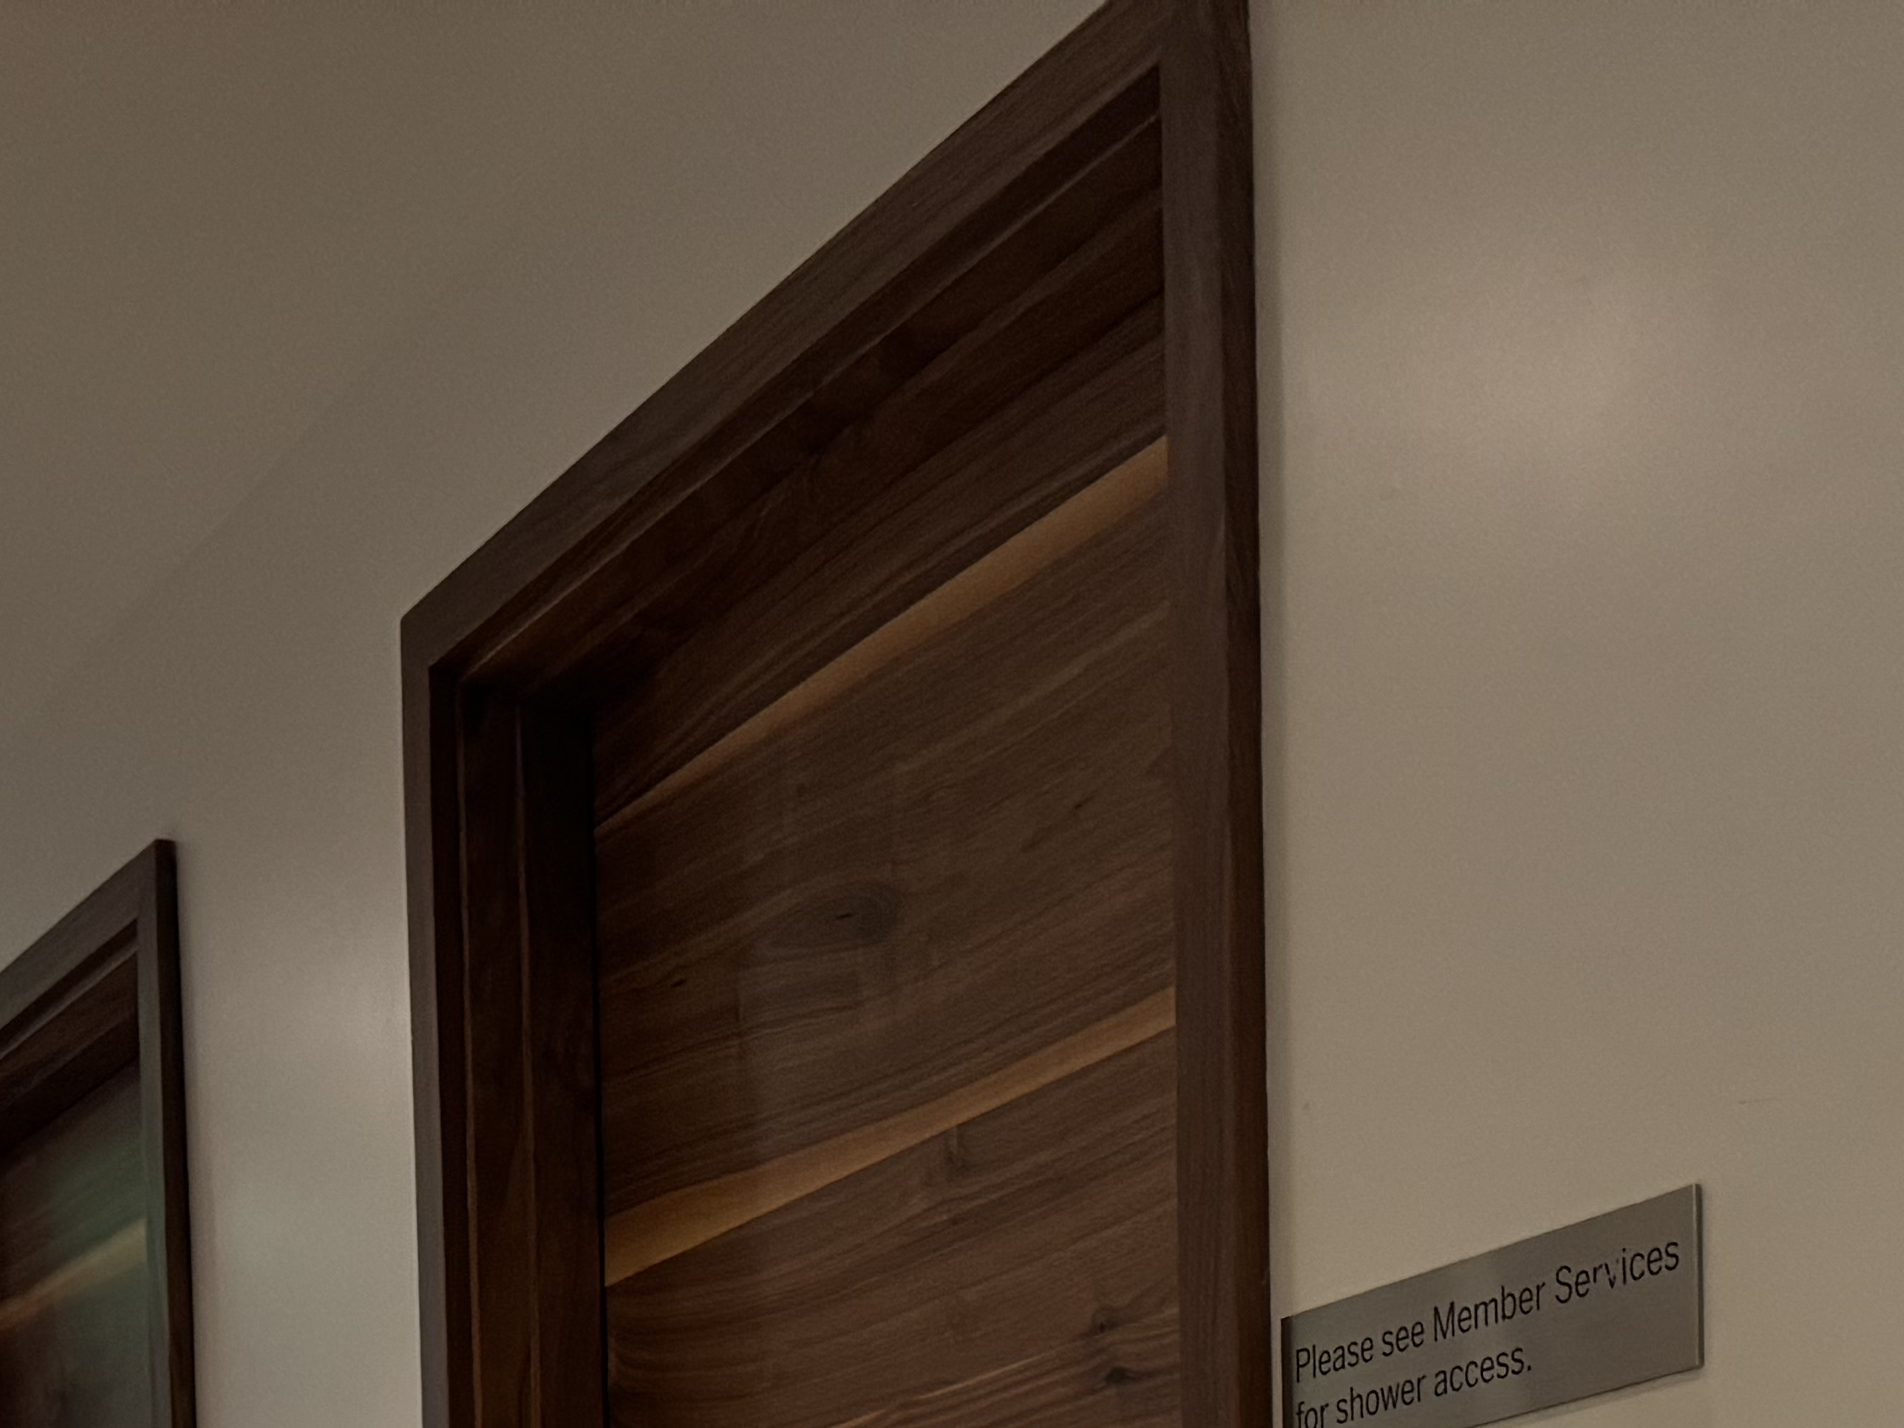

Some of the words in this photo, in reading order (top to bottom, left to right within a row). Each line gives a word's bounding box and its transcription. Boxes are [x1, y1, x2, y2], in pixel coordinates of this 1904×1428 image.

[1296, 1336, 1374, 1383] Please
[1382, 1320, 1425, 1358] see
[1433, 1281, 1546, 1342] Member
[1555, 1241, 1680, 1304] Services
[1337, 1376, 1427, 1423] shower
[1435, 1347, 1532, 1396] access.
